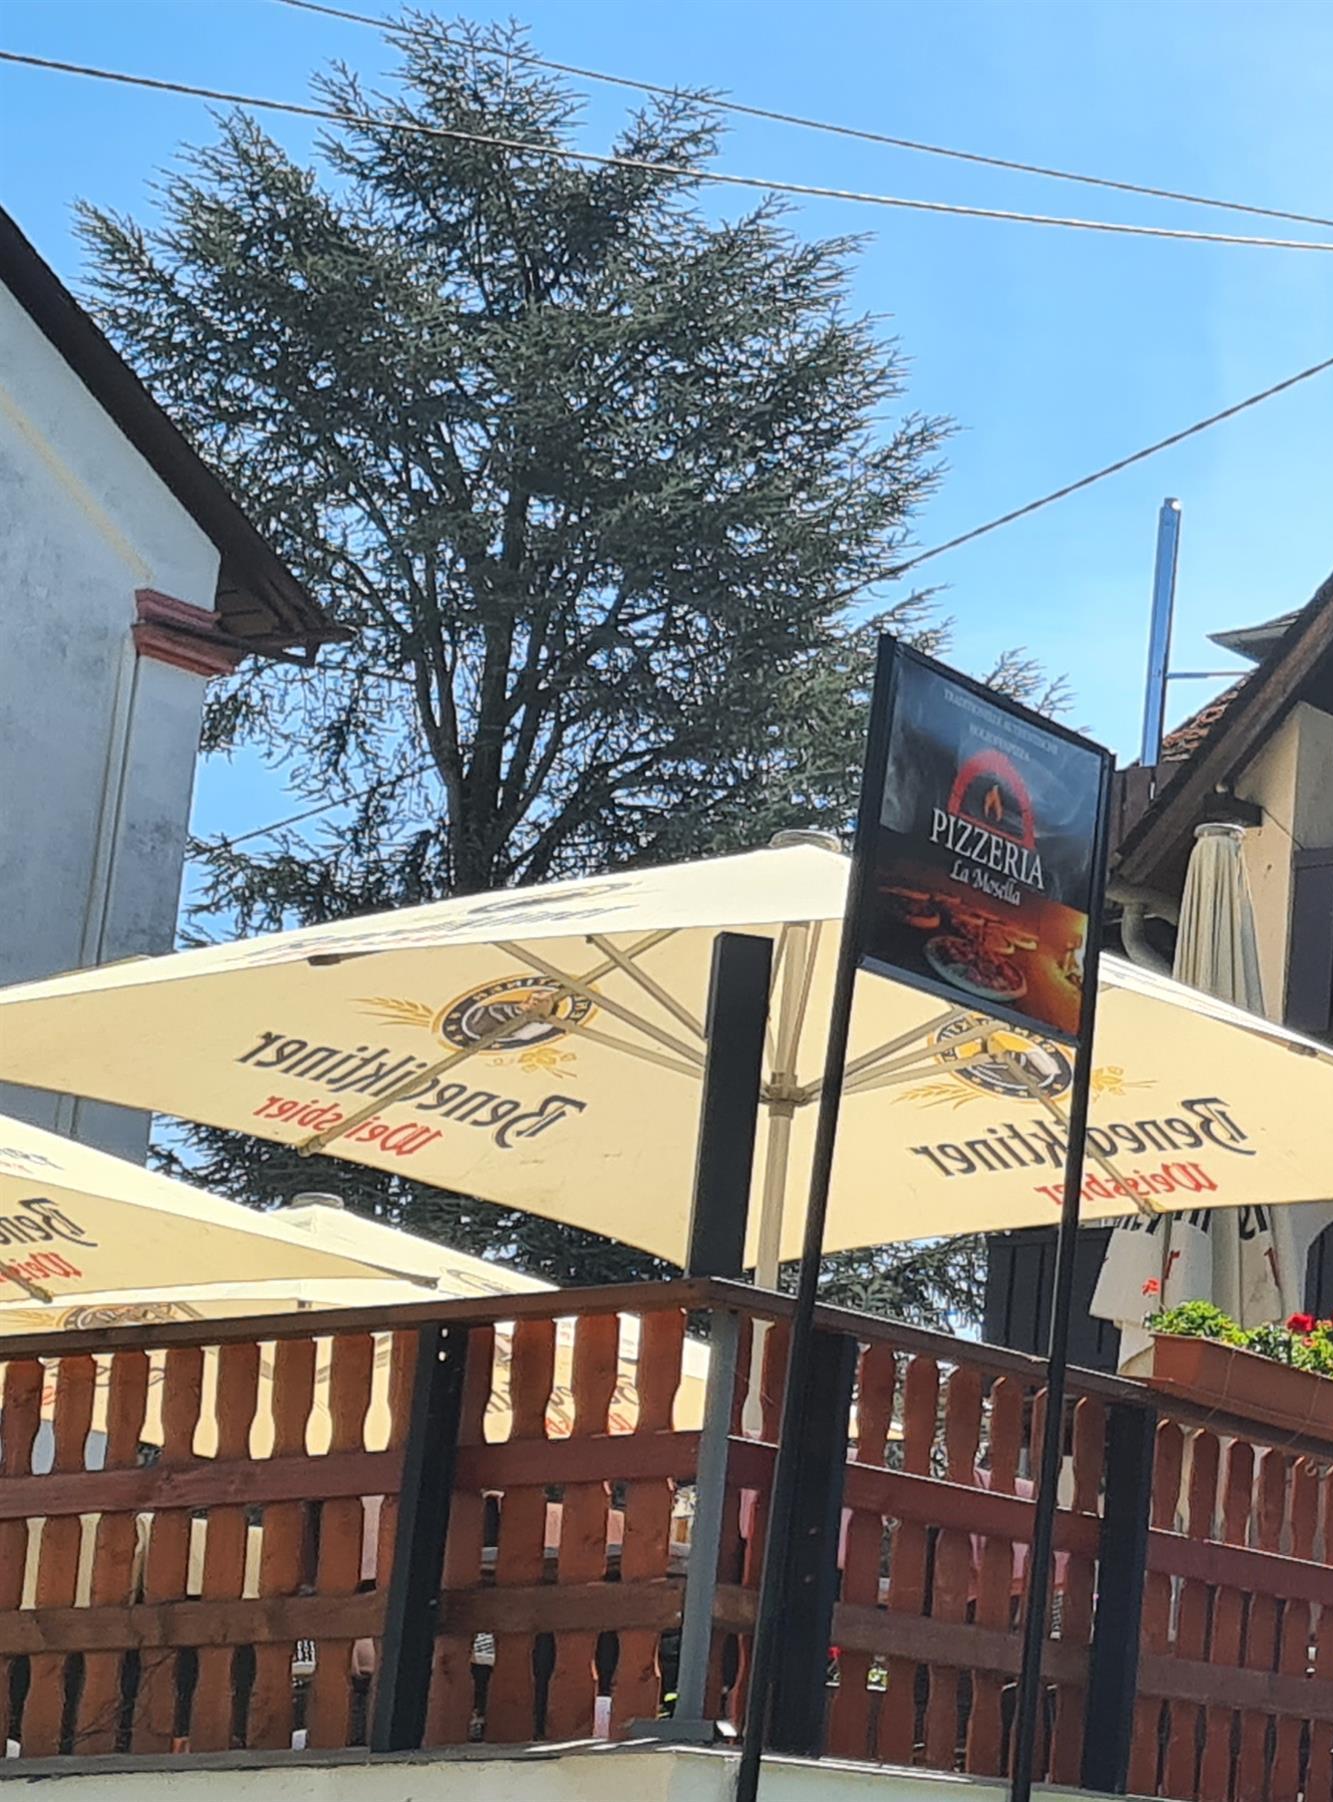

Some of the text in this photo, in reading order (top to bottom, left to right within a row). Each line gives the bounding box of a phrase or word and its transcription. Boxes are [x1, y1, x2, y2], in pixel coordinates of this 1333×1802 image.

[929, 807, 1045, 890] PIZZERIA
[949, 860, 1021, 906] La Mosella
